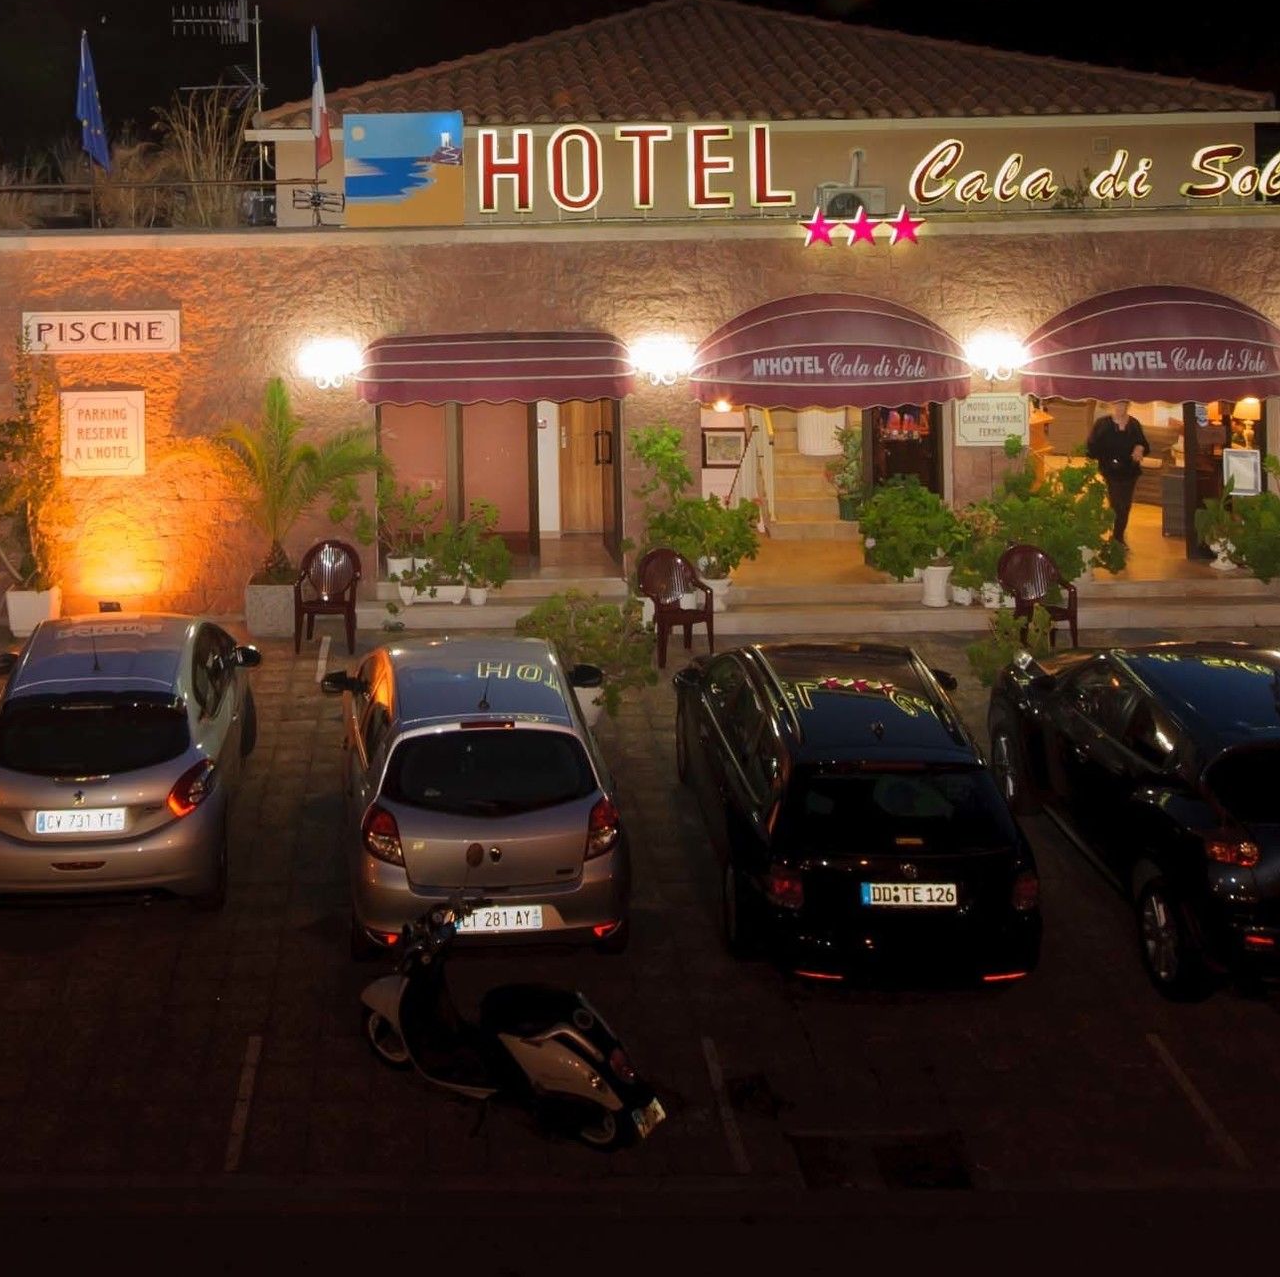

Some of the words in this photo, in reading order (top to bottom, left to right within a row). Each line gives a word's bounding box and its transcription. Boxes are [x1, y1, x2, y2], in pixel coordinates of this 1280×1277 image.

[478, 122, 797, 213] HOTEL
[908, 138, 1059, 205] Cala
[1089, 149, 1154, 199] di
[36, 321, 164, 342] PISCINE
[753, 356, 824, 376] M'HOTEL
[827, 351, 871, 377] Cala
[873, 354, 892, 377] di
[894, 352, 927, 378] Sole
[1091, 351, 1168, 371] M'HOTEL
[1170, 346, 1213, 372] Cala
[1216, 348, 1234, 372] di
[77, 407, 128, 421] PARKING
[74, 447, 82, 460] A
[902, 886, 923, 902] TE
[925, 886, 955, 902] 126
[485, 911, 508, 927] 281
[516, 910, 531, 926] AY
